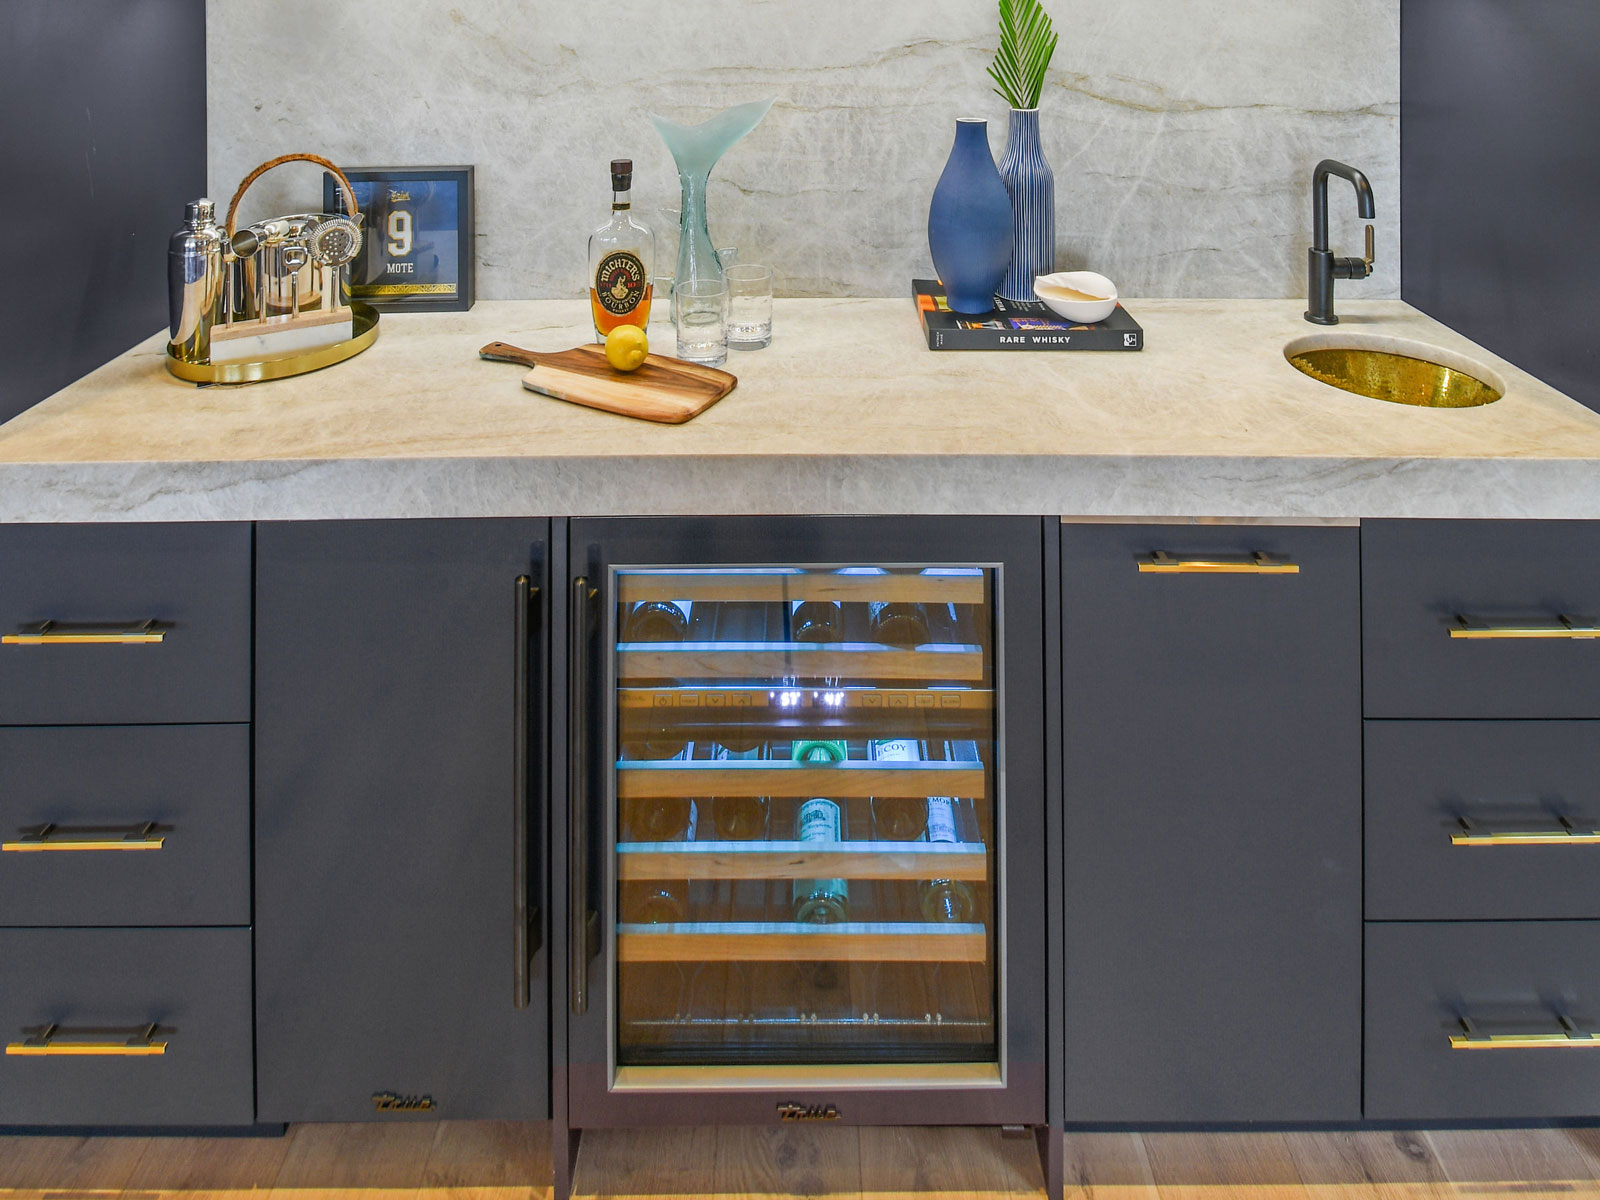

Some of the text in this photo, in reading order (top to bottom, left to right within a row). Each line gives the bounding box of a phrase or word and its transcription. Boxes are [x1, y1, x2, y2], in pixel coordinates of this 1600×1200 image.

[387, 210, 413, 257] 9
[386, 262, 414, 274] MOTE
[601, 258, 640, 282] MICHTER'S
[601, 290, 640, 309] BOURBON
